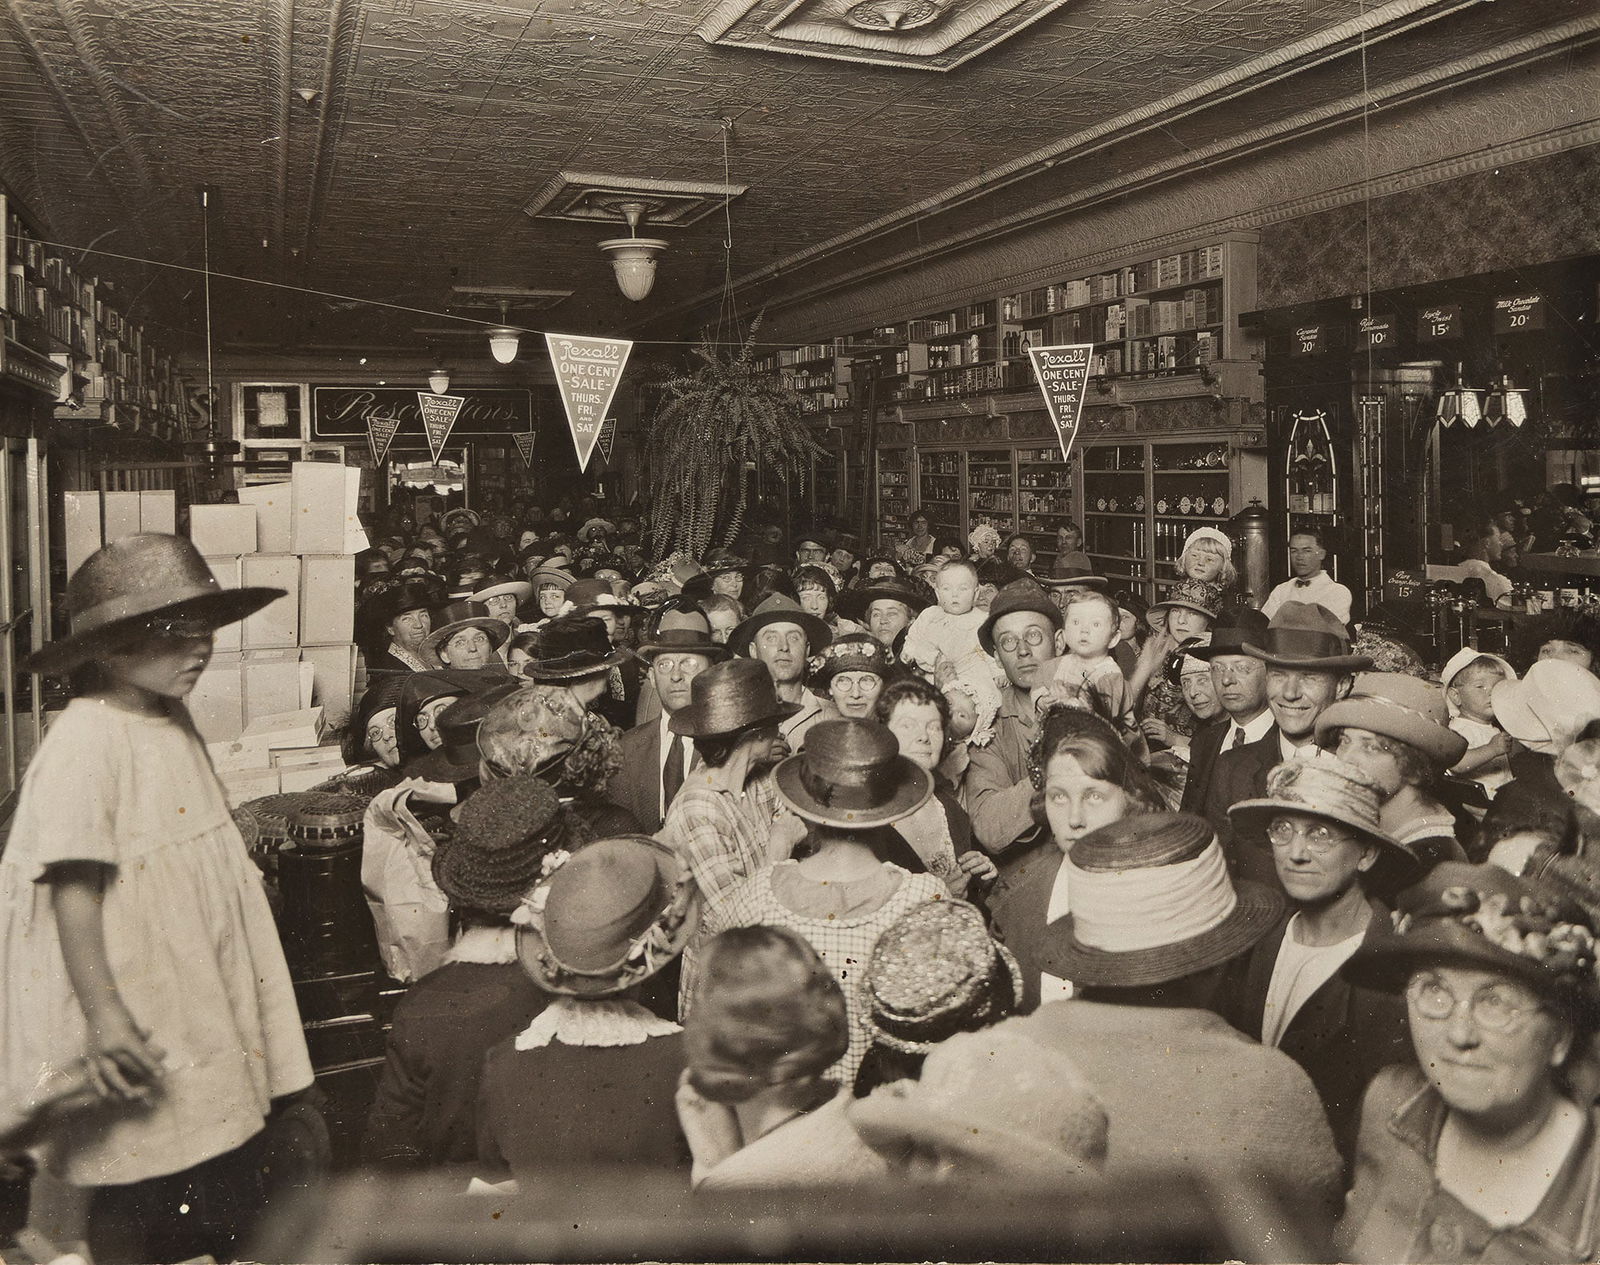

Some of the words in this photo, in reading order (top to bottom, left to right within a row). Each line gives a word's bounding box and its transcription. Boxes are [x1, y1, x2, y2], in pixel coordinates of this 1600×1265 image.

[559, 340, 620, 364] Rexall
[1040, 349, 1086, 369] Rexall
[560, 361, 586, 375] ONE
[587, 364, 618, 378] CENT
[1042, 370, 1062, 380] ONE
[1063, 368, 1086, 379] CENT
[424, 396, 457, 410] Rexall
[424, 407, 438, 415] ONE
[439, 409, 456, 417] CENT
